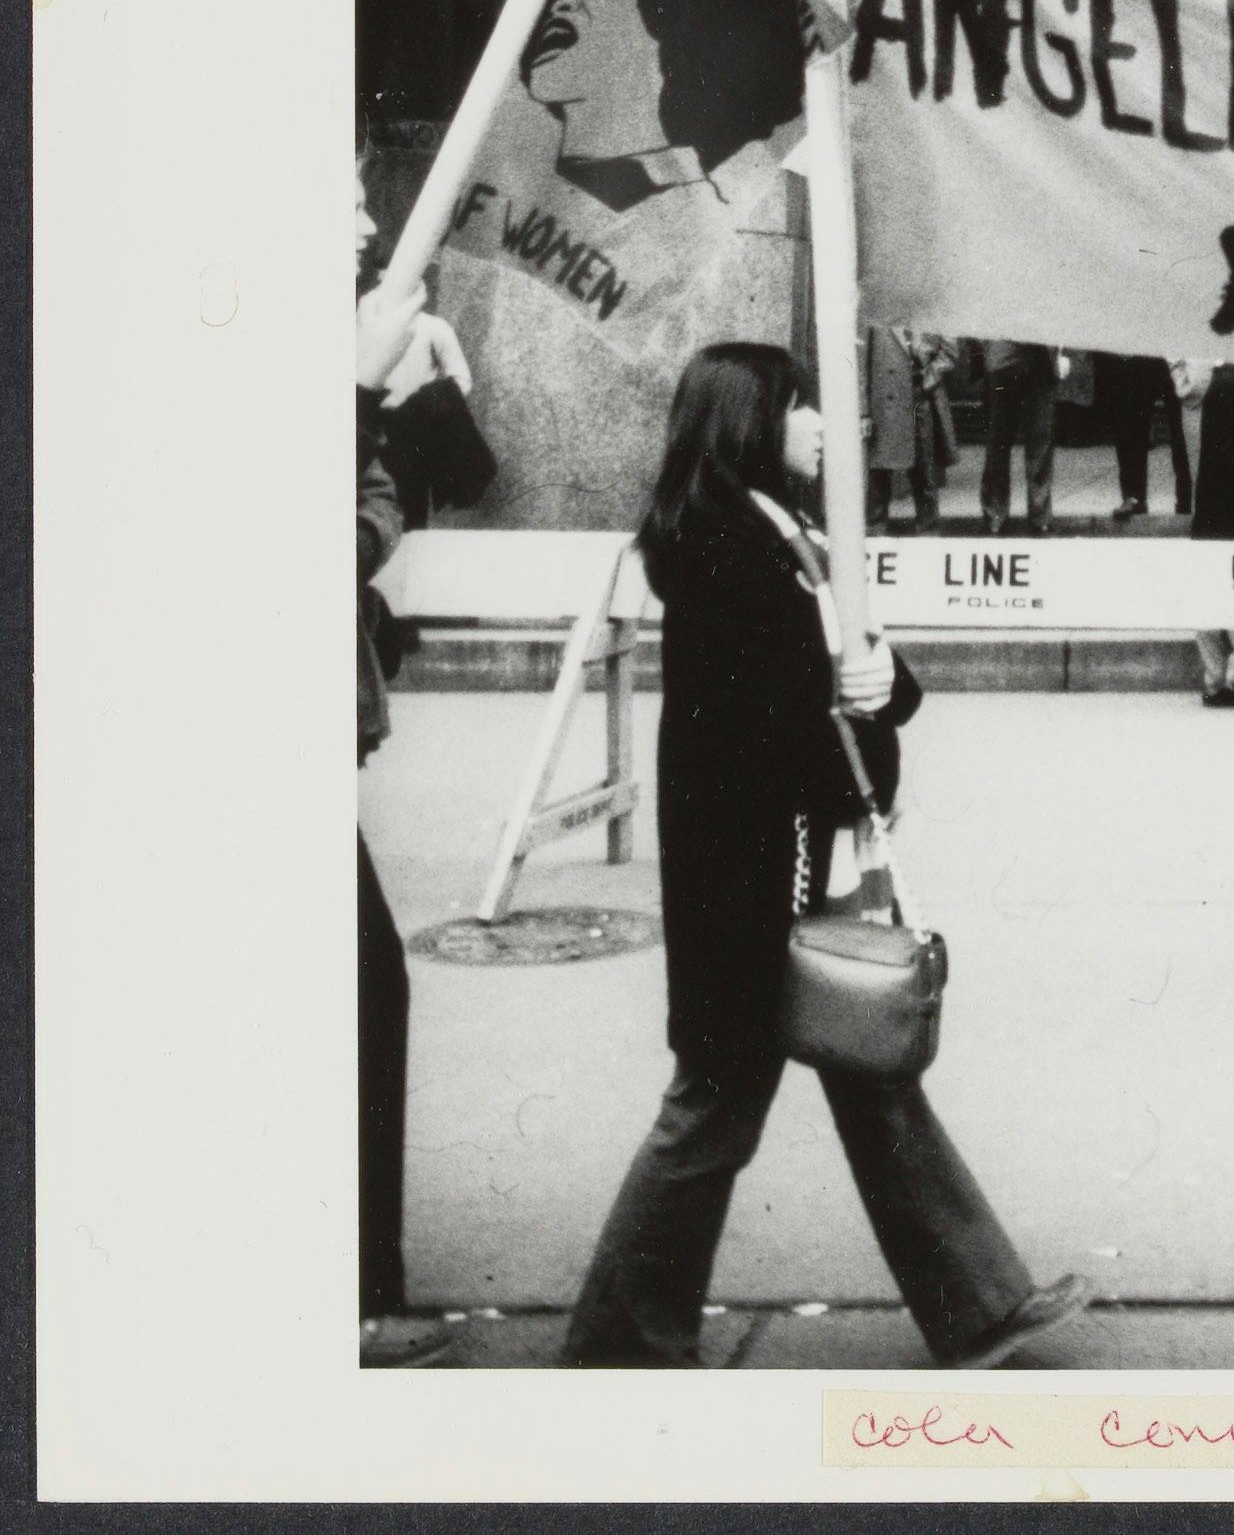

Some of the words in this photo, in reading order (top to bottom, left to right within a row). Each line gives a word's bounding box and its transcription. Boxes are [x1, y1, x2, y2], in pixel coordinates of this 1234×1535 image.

[502, 199, 628, 322] WOMEN
[944, 553, 1030, 587] LINE
[947, 596, 1044, 609] POLICE
[850, 1409, 1015, 1451] color
